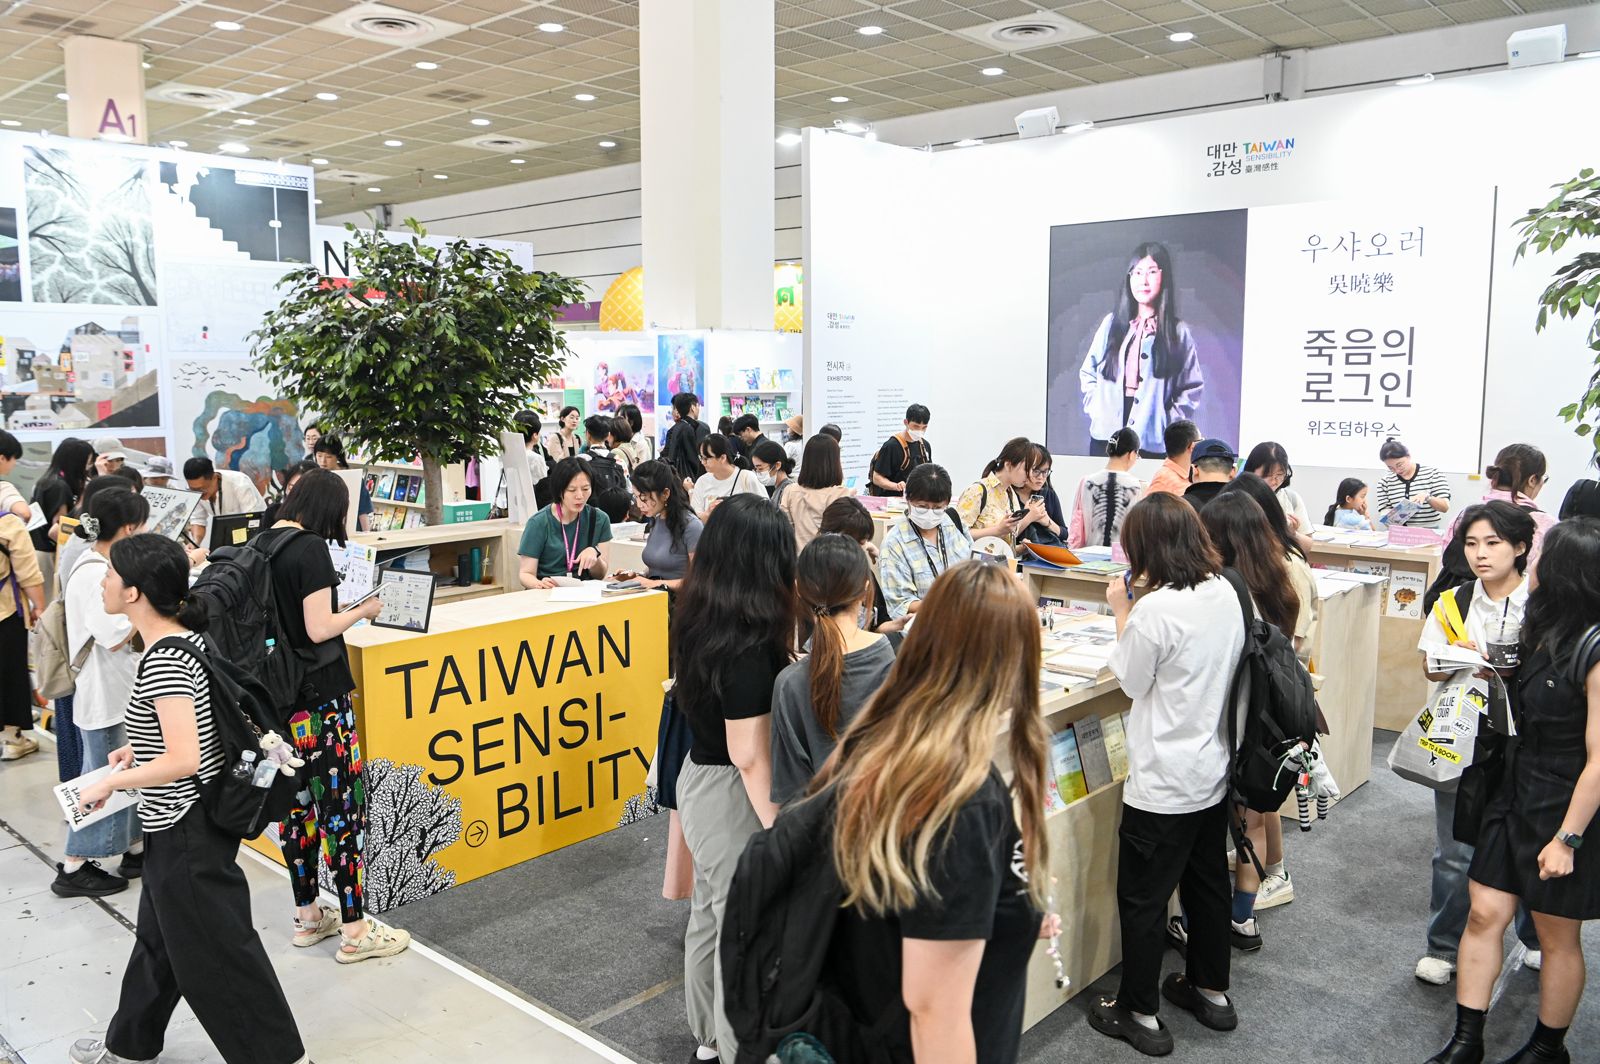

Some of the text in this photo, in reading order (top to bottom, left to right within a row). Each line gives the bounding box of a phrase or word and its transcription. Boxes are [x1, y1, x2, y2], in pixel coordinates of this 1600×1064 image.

[99, 98, 137, 137] A1
[1207, 142, 1238, 159] 대만
[1245, 151, 1292, 162] SENSIBILITY
[1212, 159, 1242, 177] 감성
[1300, 226, 1424, 264] 우샤오러
[1328, 272, 1394, 295] 吳曉樂
[1303, 326, 1415, 366] 죽음의
[826, 361, 845, 372] 전시자
[1301, 369, 1413, 408] 로그인
[1307, 420, 1403, 438] 위즈덤하우스
[384, 619, 631, 719] TAIWAN
[1436, 707, 1450, 718] TOUR
[1455, 722, 1470, 732] MLT
[427, 692, 627, 786] SENSI-
